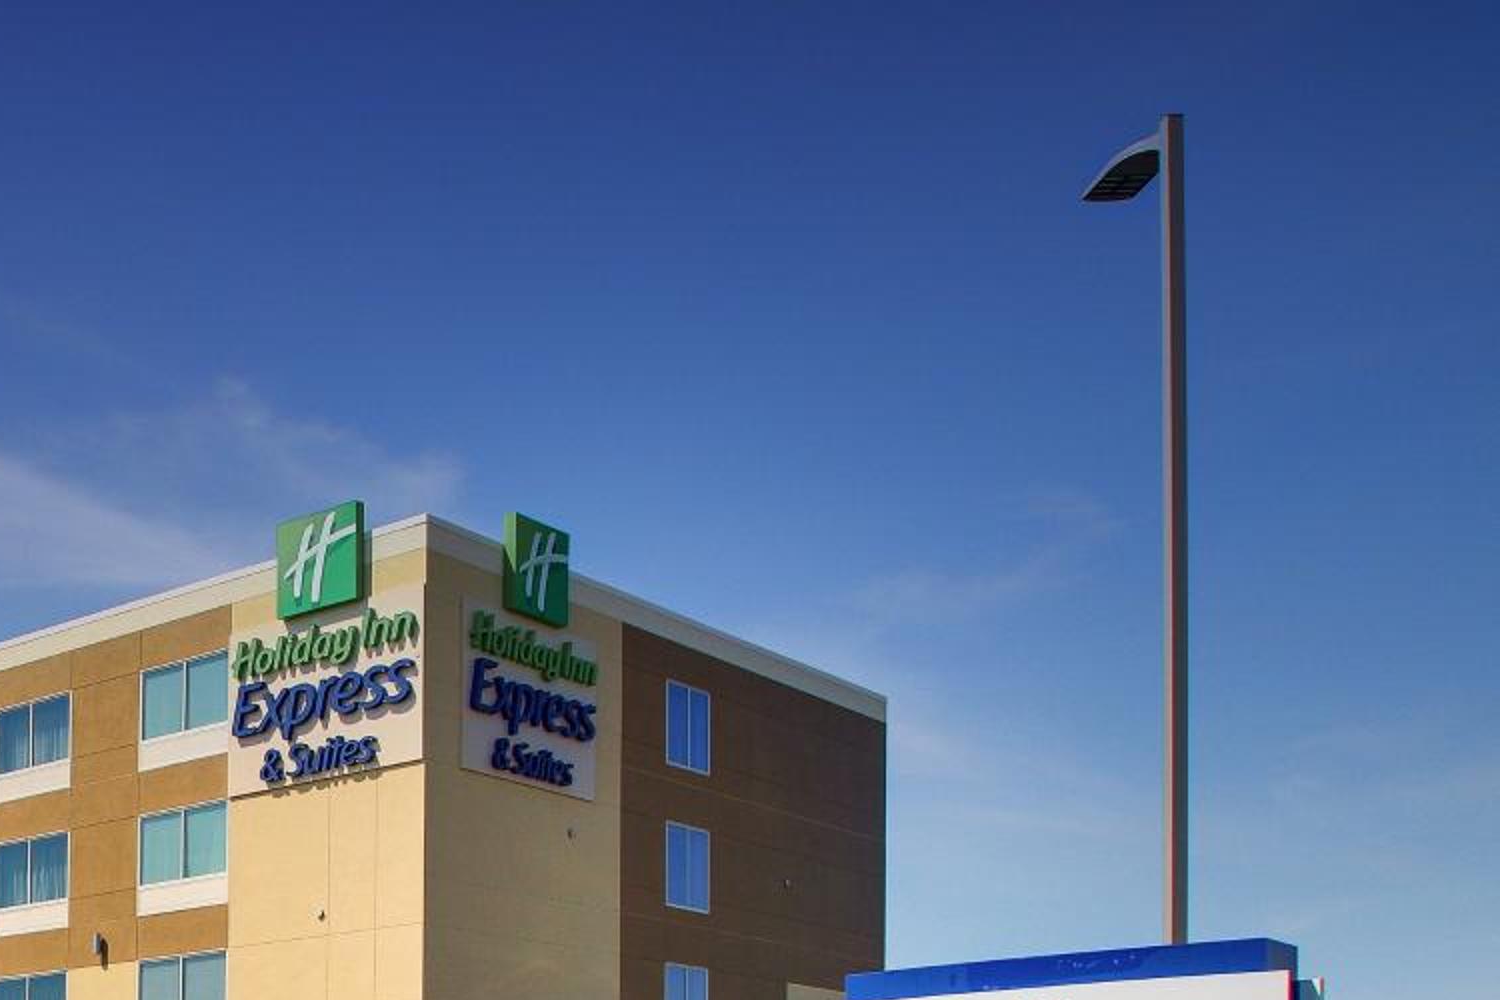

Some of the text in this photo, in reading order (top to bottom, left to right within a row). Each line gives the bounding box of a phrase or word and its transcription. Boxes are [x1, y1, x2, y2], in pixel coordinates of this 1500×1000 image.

[232, 608, 419, 681] Holiday Inn
[470, 610, 596, 686] Holiday Inn
[232, 658, 416, 740] Express
[470, 657, 596, 741] Express
[260, 735, 379, 781] & Suites
[491, 738, 573, 786] & Suites
